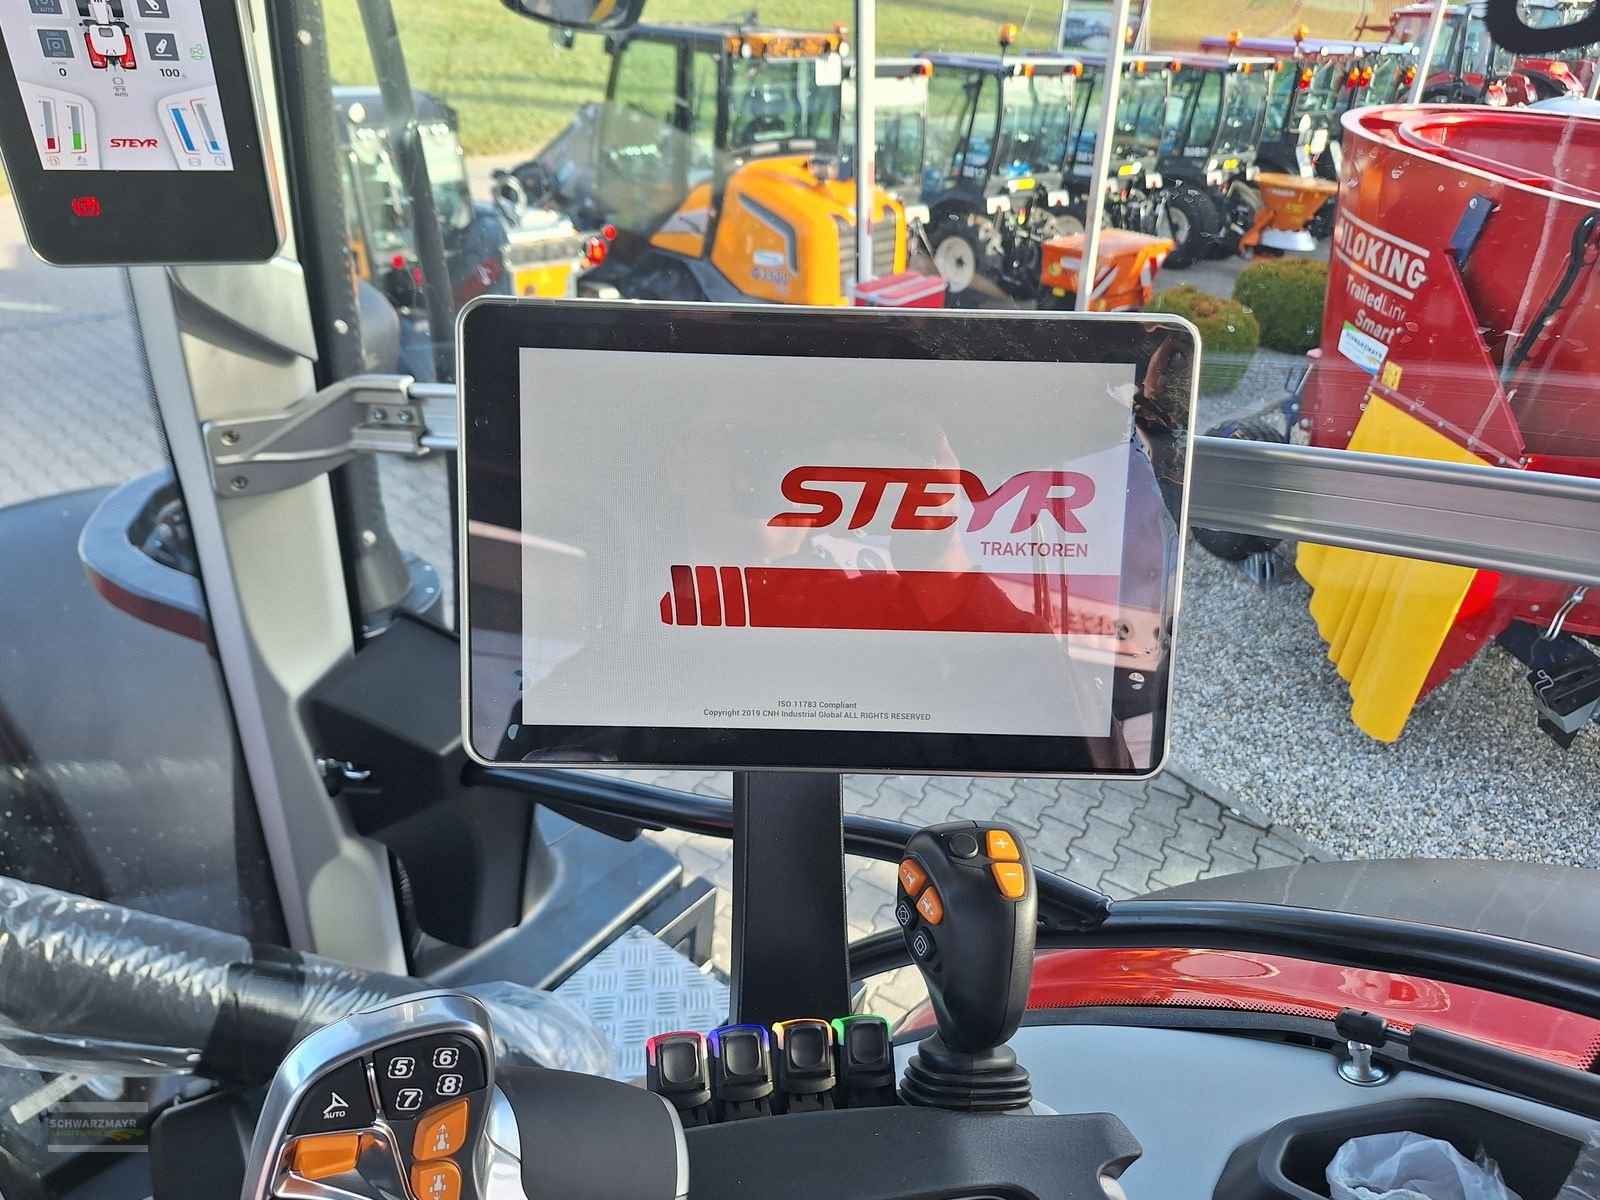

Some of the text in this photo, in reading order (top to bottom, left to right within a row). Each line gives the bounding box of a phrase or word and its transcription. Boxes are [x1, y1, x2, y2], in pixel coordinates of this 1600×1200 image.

[59, 68, 67, 77] 0
[159, 68, 180, 78] 100
[110, 138, 158, 148] STEYR
[766, 465, 1096, 534] STEYR
[980, 540, 1088, 558] TRAKTOREN
[778, 700, 857, 710] ISO 11783 Compliant
[703, 708, 740, 718] Copyright
[742, 709, 761, 717] 2019
[762, 709, 780, 717] CNH
[781, 710, 817, 718] Industrial
[819, 711, 843, 719] Global
[860, 712, 889, 720] RIGHTS
[891, 713, 931, 721] RESERVED
[439, 1050, 453, 1065] 6
[394, 1059, 408, 1076] 5
[442, 1076, 457, 1093] 8
[403, 1091, 418, 1108] 7
[323, 1110, 346, 1120] AUTO
